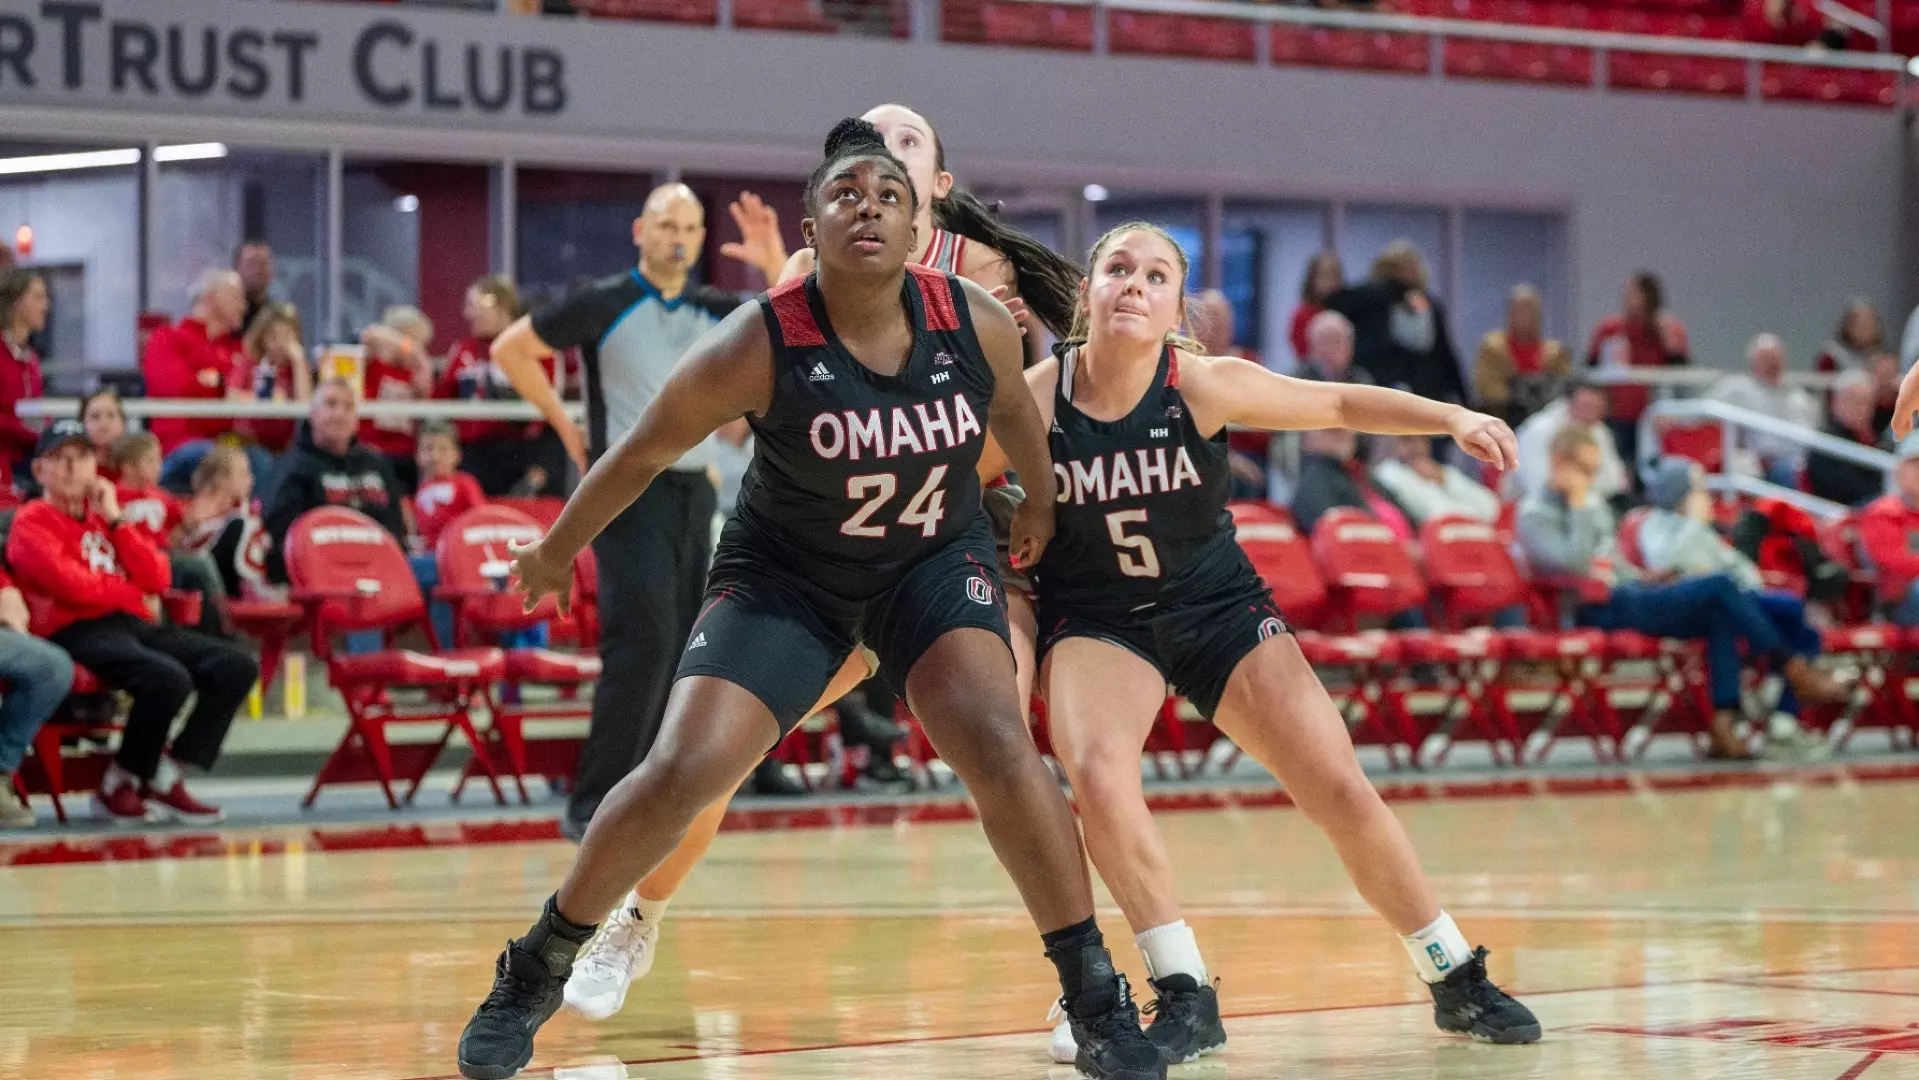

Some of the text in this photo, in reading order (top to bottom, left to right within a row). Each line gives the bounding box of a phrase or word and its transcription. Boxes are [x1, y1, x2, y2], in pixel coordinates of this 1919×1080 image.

[353, 18, 566, 115] CLUB
[808, 373, 835, 382] adidas
[930, 370, 950, 385] HH
[809, 393, 982, 461] OMAHA
[1150, 427, 1169, 438] HH
[838, 463, 950, 540] 24
[1053, 445, 1203, 505] OMAHA
[1104, 507, 1162, 579] 5
